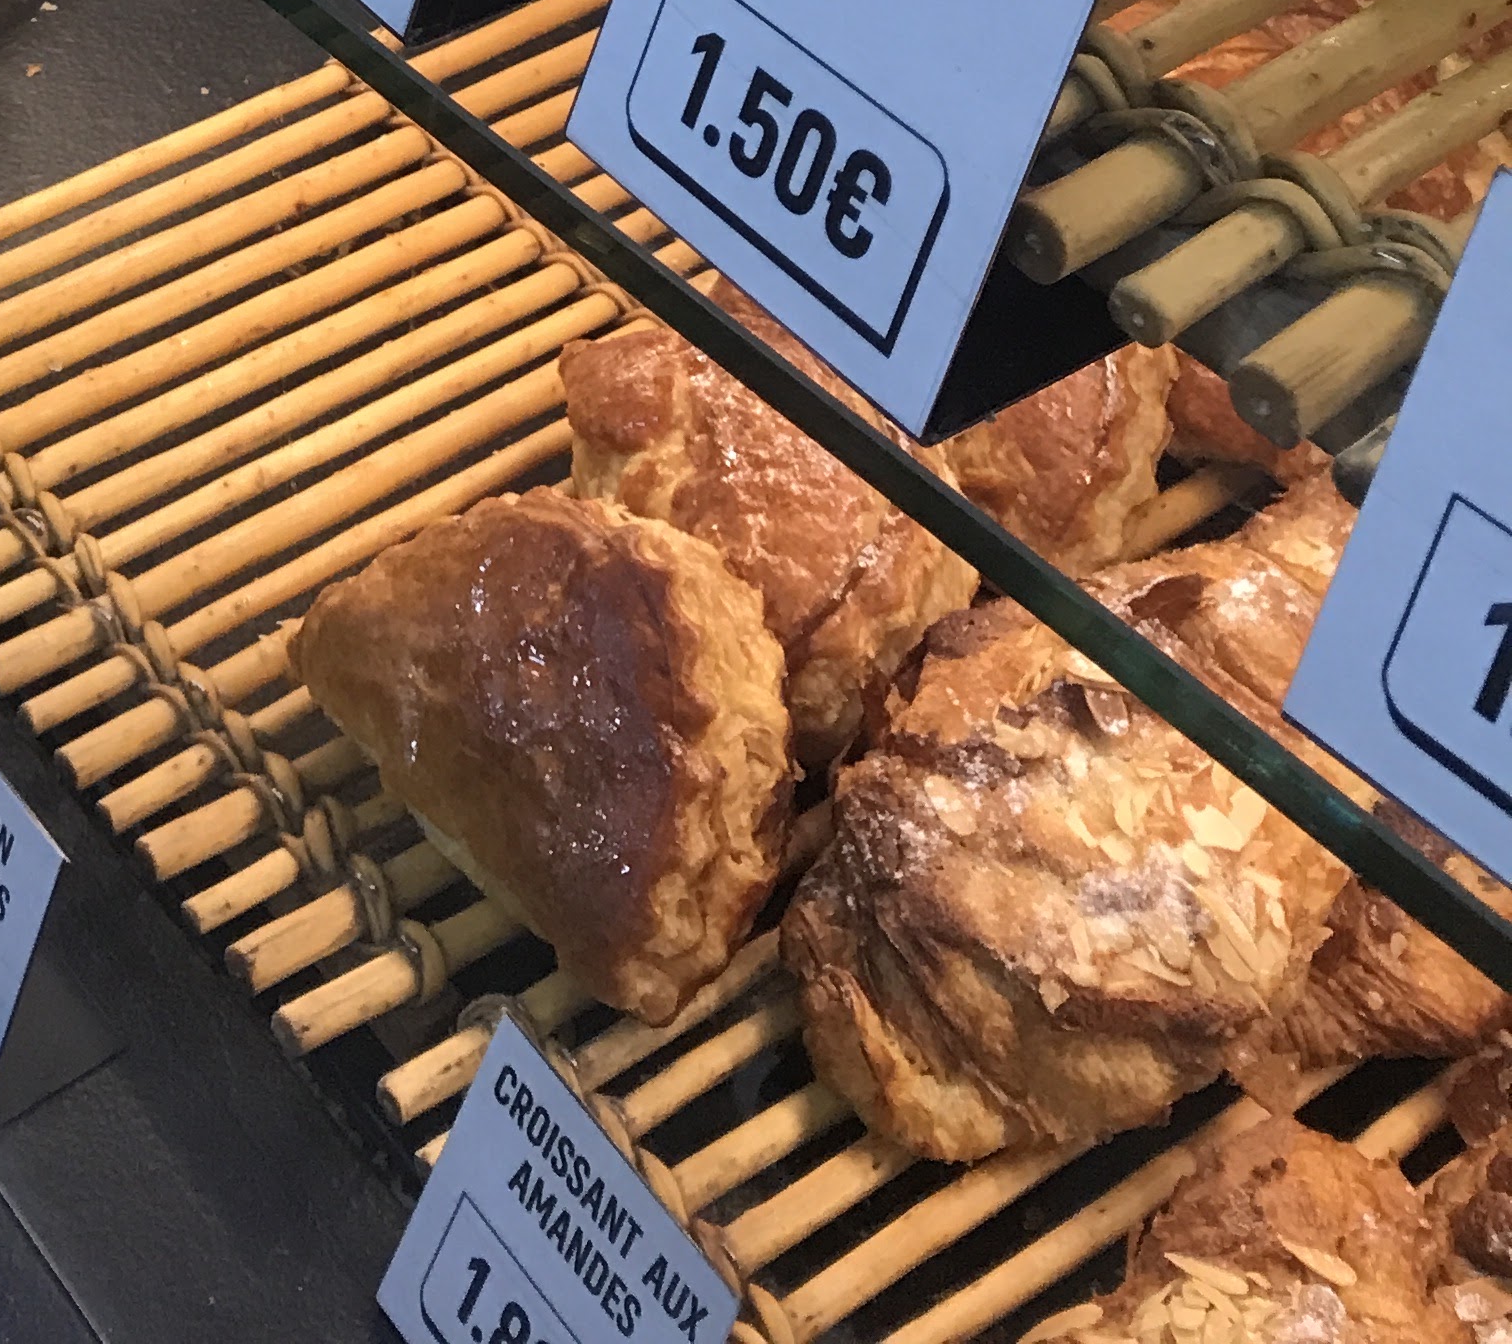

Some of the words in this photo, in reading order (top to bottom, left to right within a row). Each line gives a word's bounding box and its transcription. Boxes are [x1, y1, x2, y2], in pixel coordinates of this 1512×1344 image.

[679, 32, 894, 260] 1.50€
[493, 1065, 644, 1260] CROISSANT
[641, 1253, 709, 1344] AUX
[507, 1160, 642, 1338] AMANDES
